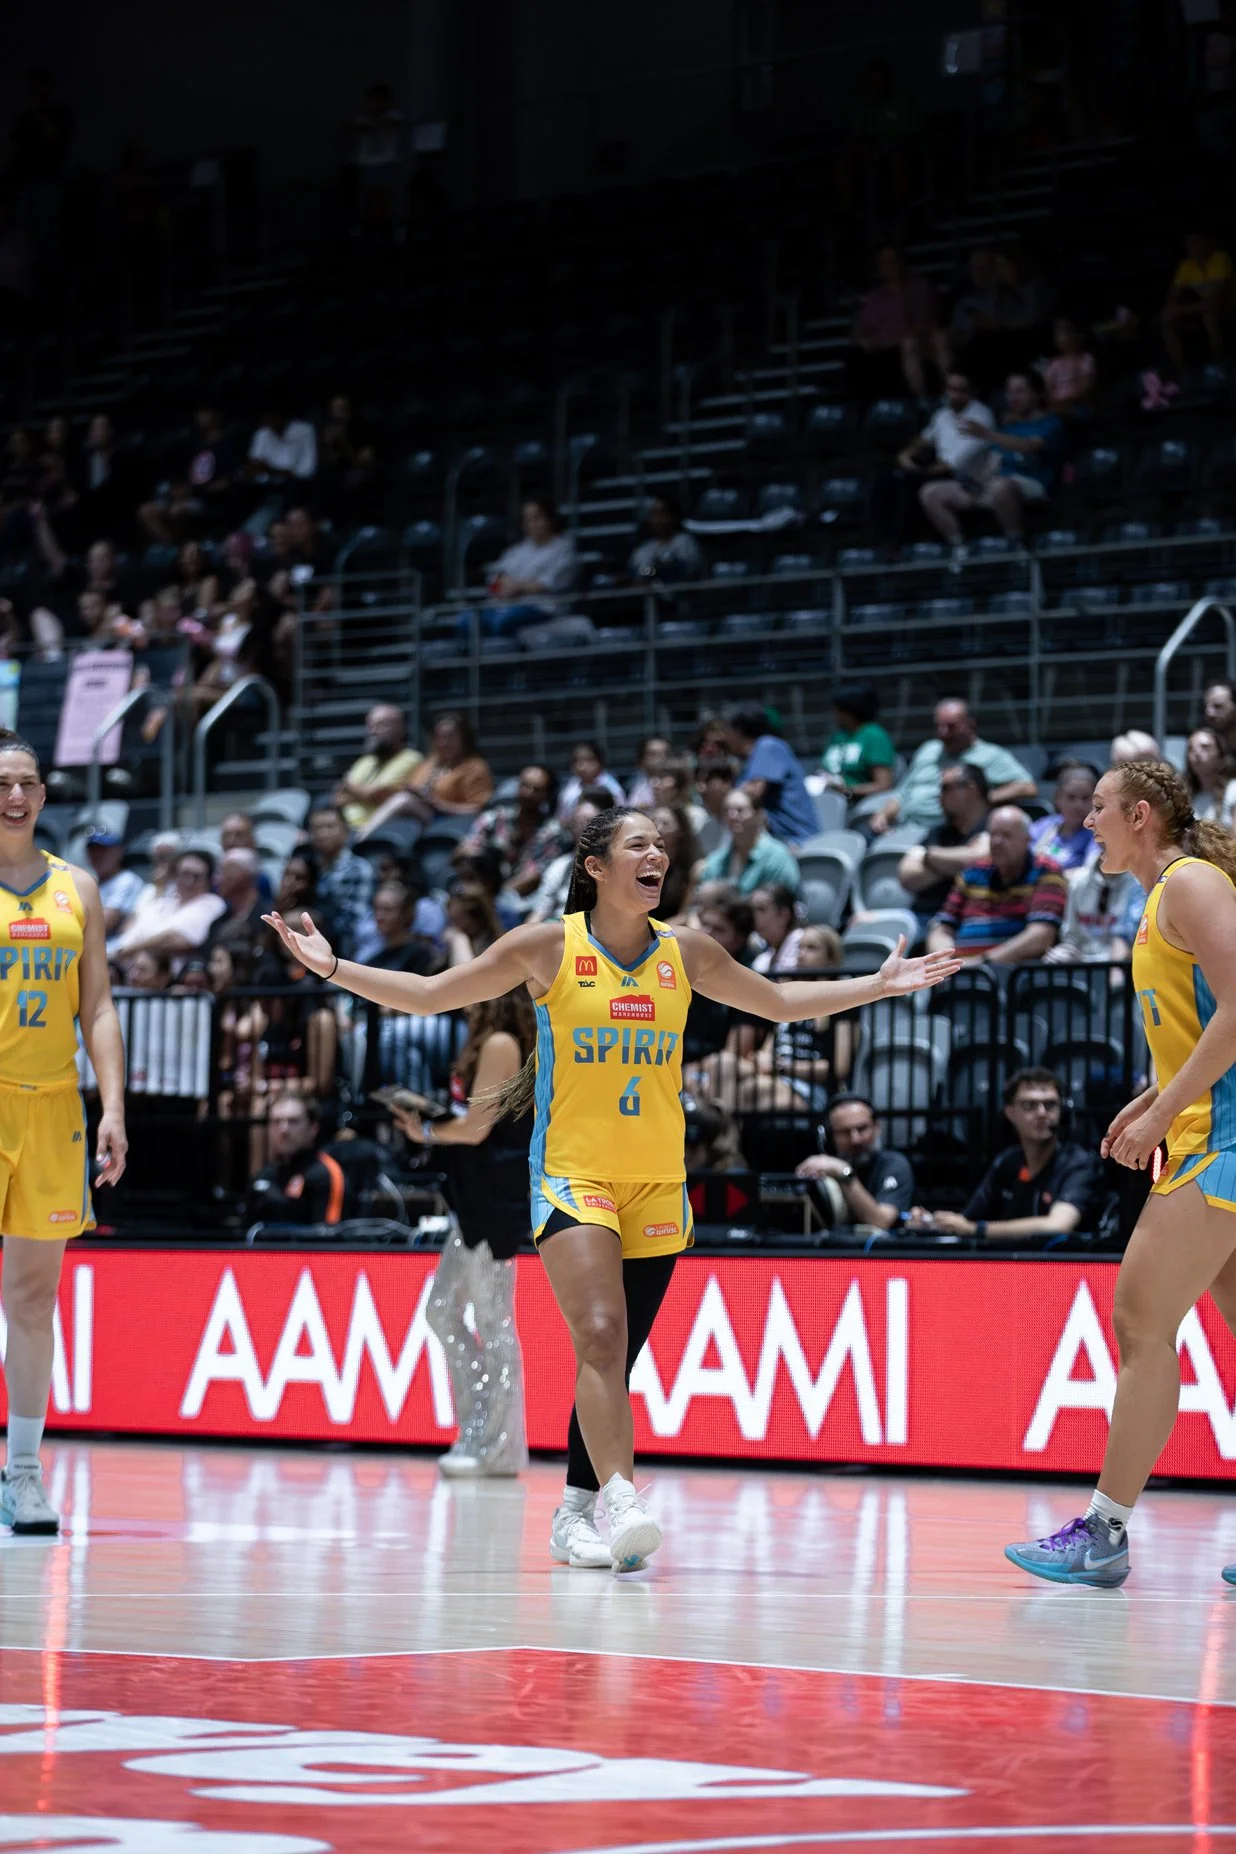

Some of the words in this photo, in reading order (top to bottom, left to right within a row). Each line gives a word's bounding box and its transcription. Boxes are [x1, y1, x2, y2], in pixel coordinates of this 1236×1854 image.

[0, 946, 77, 981] PIRIT
[17, 990, 48, 1028] 12
[612, 1002, 653, 1013] CHEMIST
[572, 1027, 679, 1066] SPIRIT
[619, 1076, 642, 1116] 6
[179, 1266, 460, 1428] AAM
